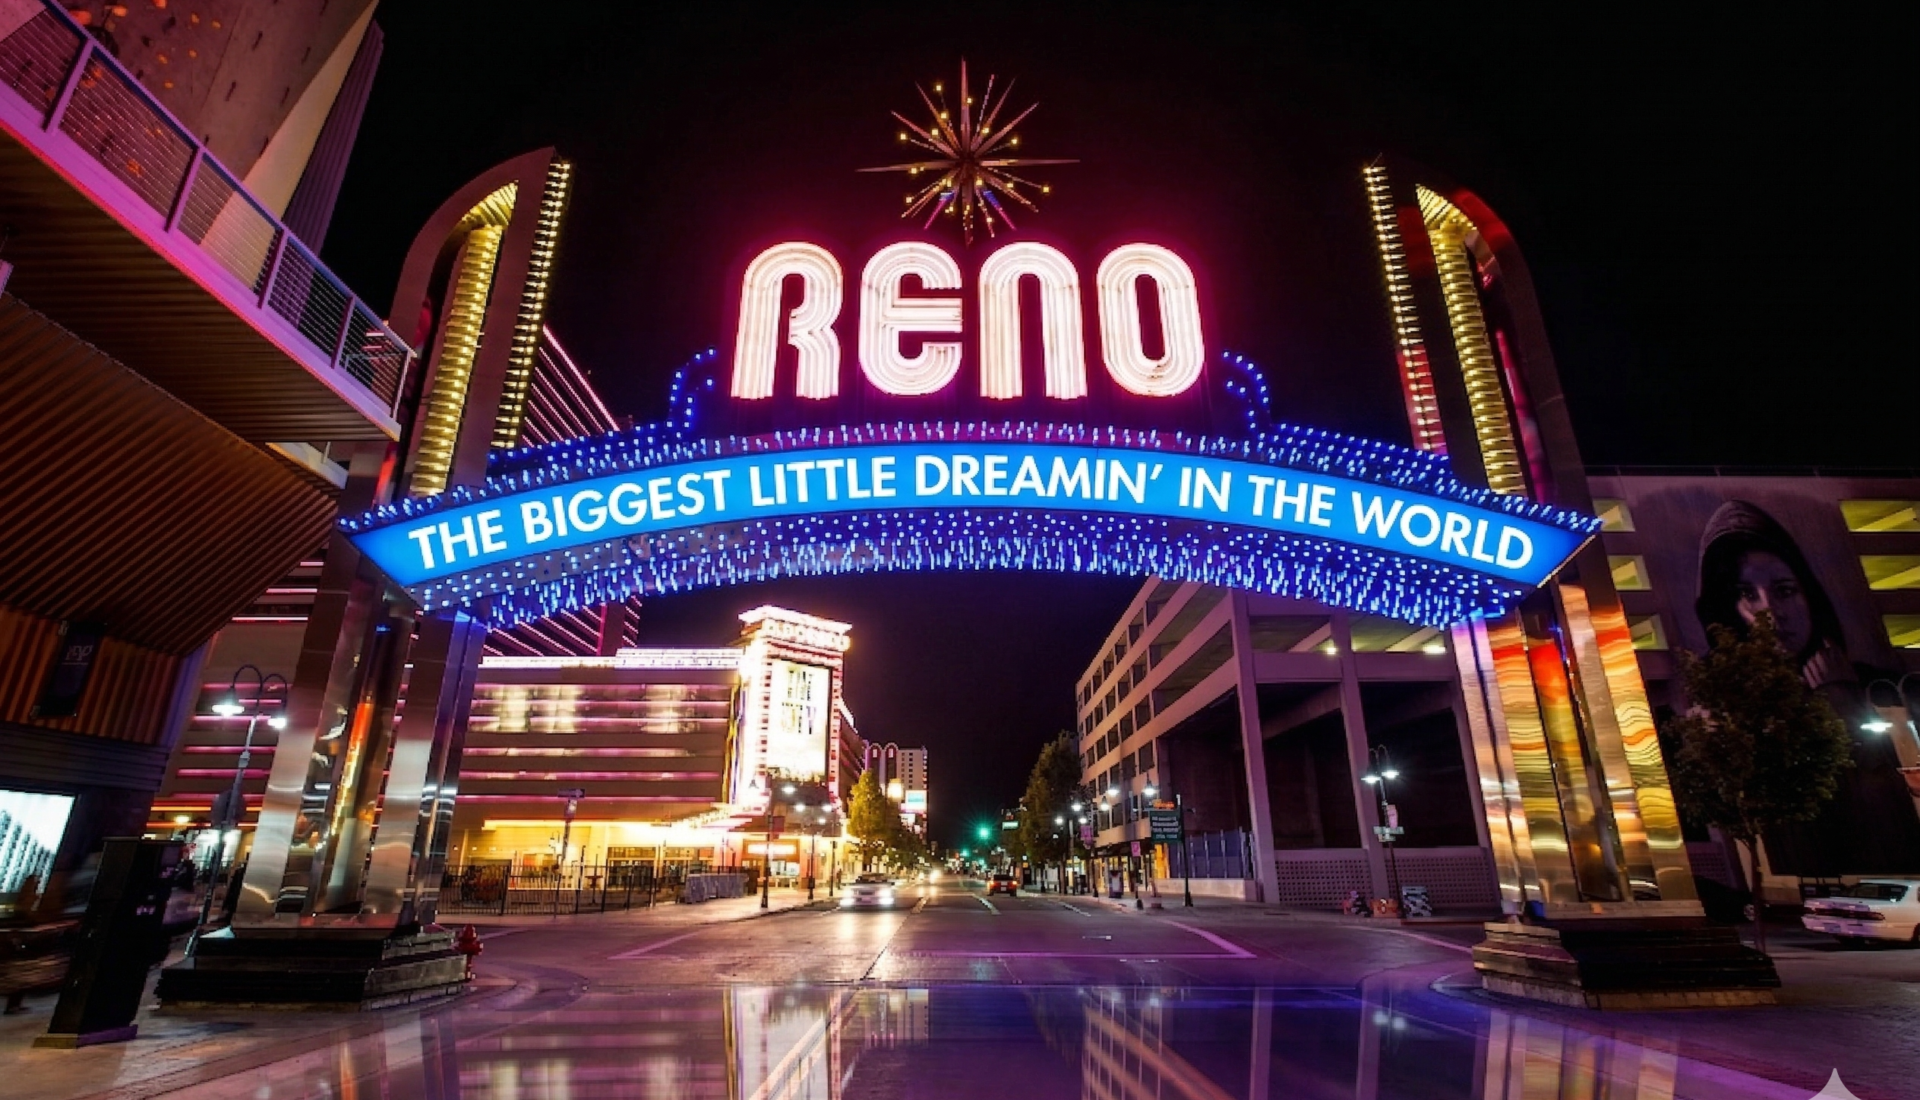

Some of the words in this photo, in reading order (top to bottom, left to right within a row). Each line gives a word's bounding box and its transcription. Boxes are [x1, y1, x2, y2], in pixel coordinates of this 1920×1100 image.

[731, 241, 1205, 400] RENO
[408, 509, 507, 569] THE
[520, 469, 731, 544] BIGGEST
[749, 456, 896, 507] LITTLE
[915, 454, 1164, 504] DREAMIN'
[1179, 467, 1232, 512] IN
[1248, 474, 1337, 527] THE
[1351, 491, 1534, 569] WORLD
